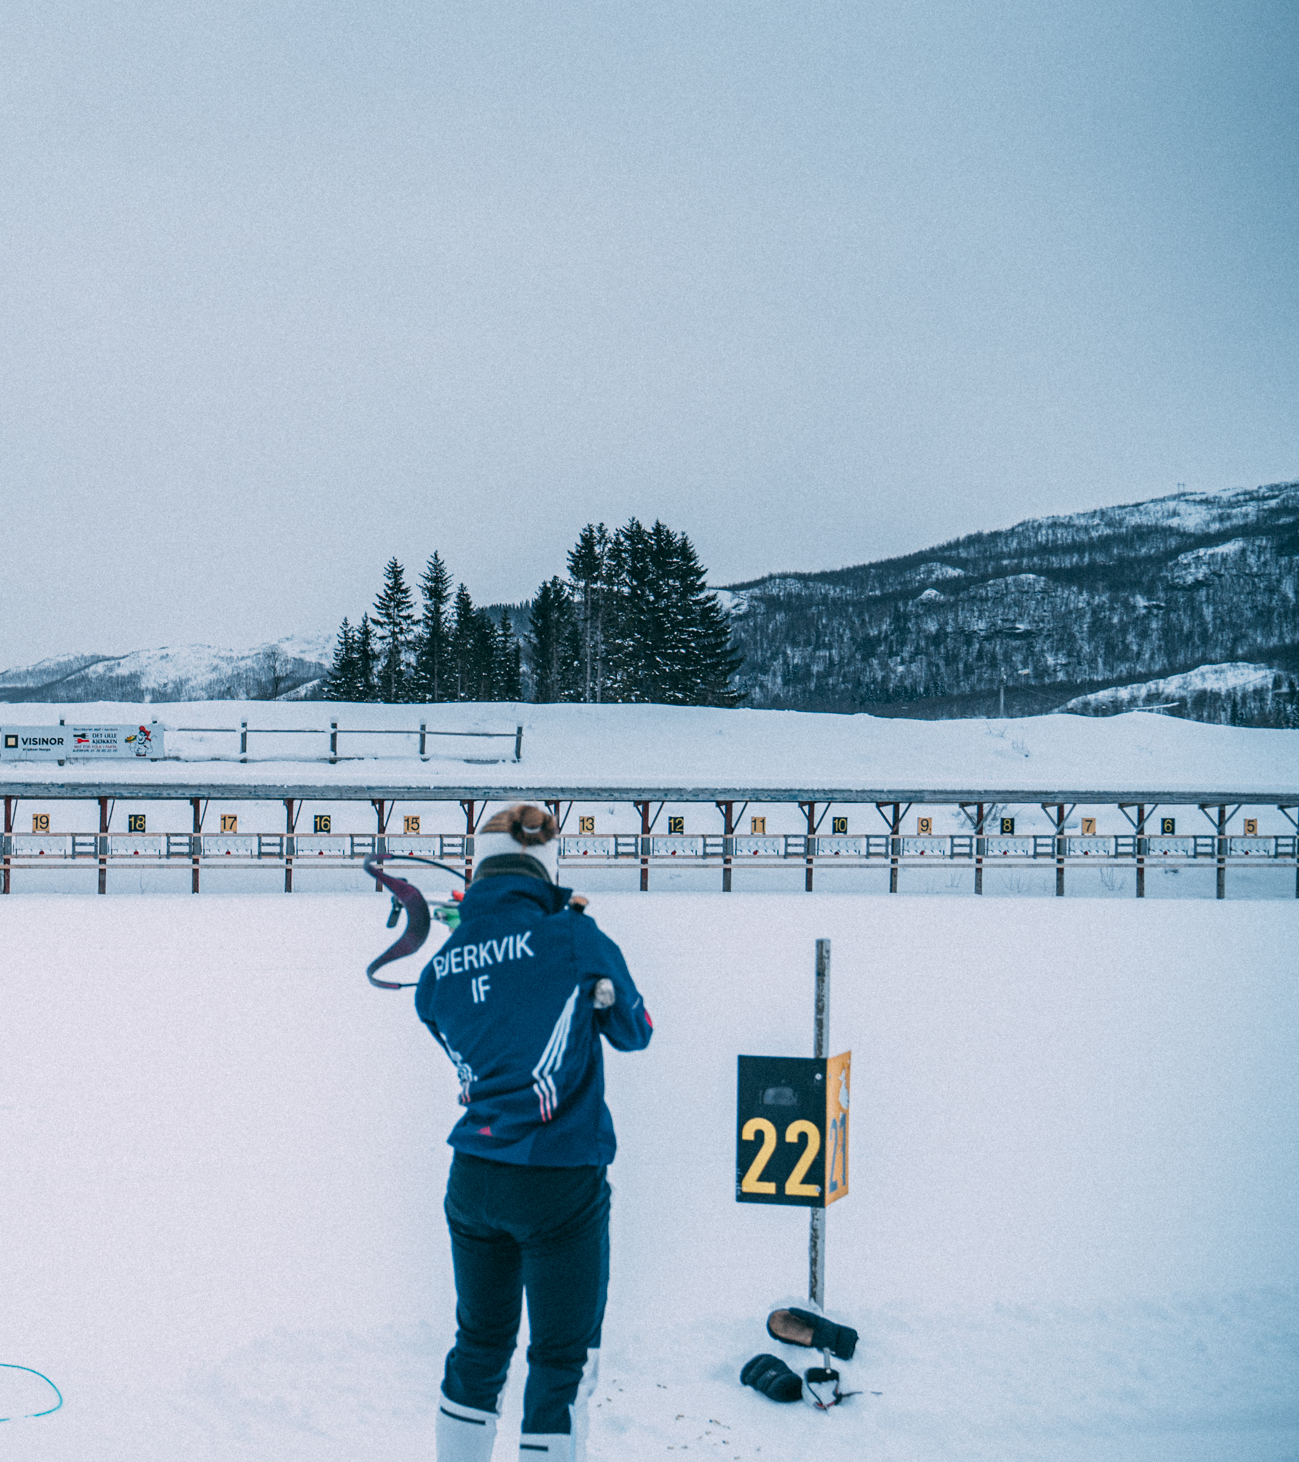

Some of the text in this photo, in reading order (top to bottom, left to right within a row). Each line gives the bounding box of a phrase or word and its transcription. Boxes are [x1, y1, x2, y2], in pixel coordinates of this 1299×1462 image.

[21, 737, 64, 746] VISINOR
[33, 815, 49, 830] 19
[129, 816, 145, 830] 18
[221, 816, 237, 830] 17
[315, 816, 330, 831] 16
[404, 817, 420, 832] 15
[580, 818, 594, 831] 13
[669, 818, 683, 832] 12
[752, 819, 765, 832] 11
[833, 818, 847, 832] 10
[920, 819, 930, 832] 9
[1003, 819, 1012, 832] 8
[1084, 819, 1093, 832] 7
[1164, 820, 1172, 832] 6
[1247, 820, 1255, 832] 5
[472, 975, 491, 1003] IF
[742, 1117, 821, 1197] 22
[829, 1112, 846, 1193] 21
